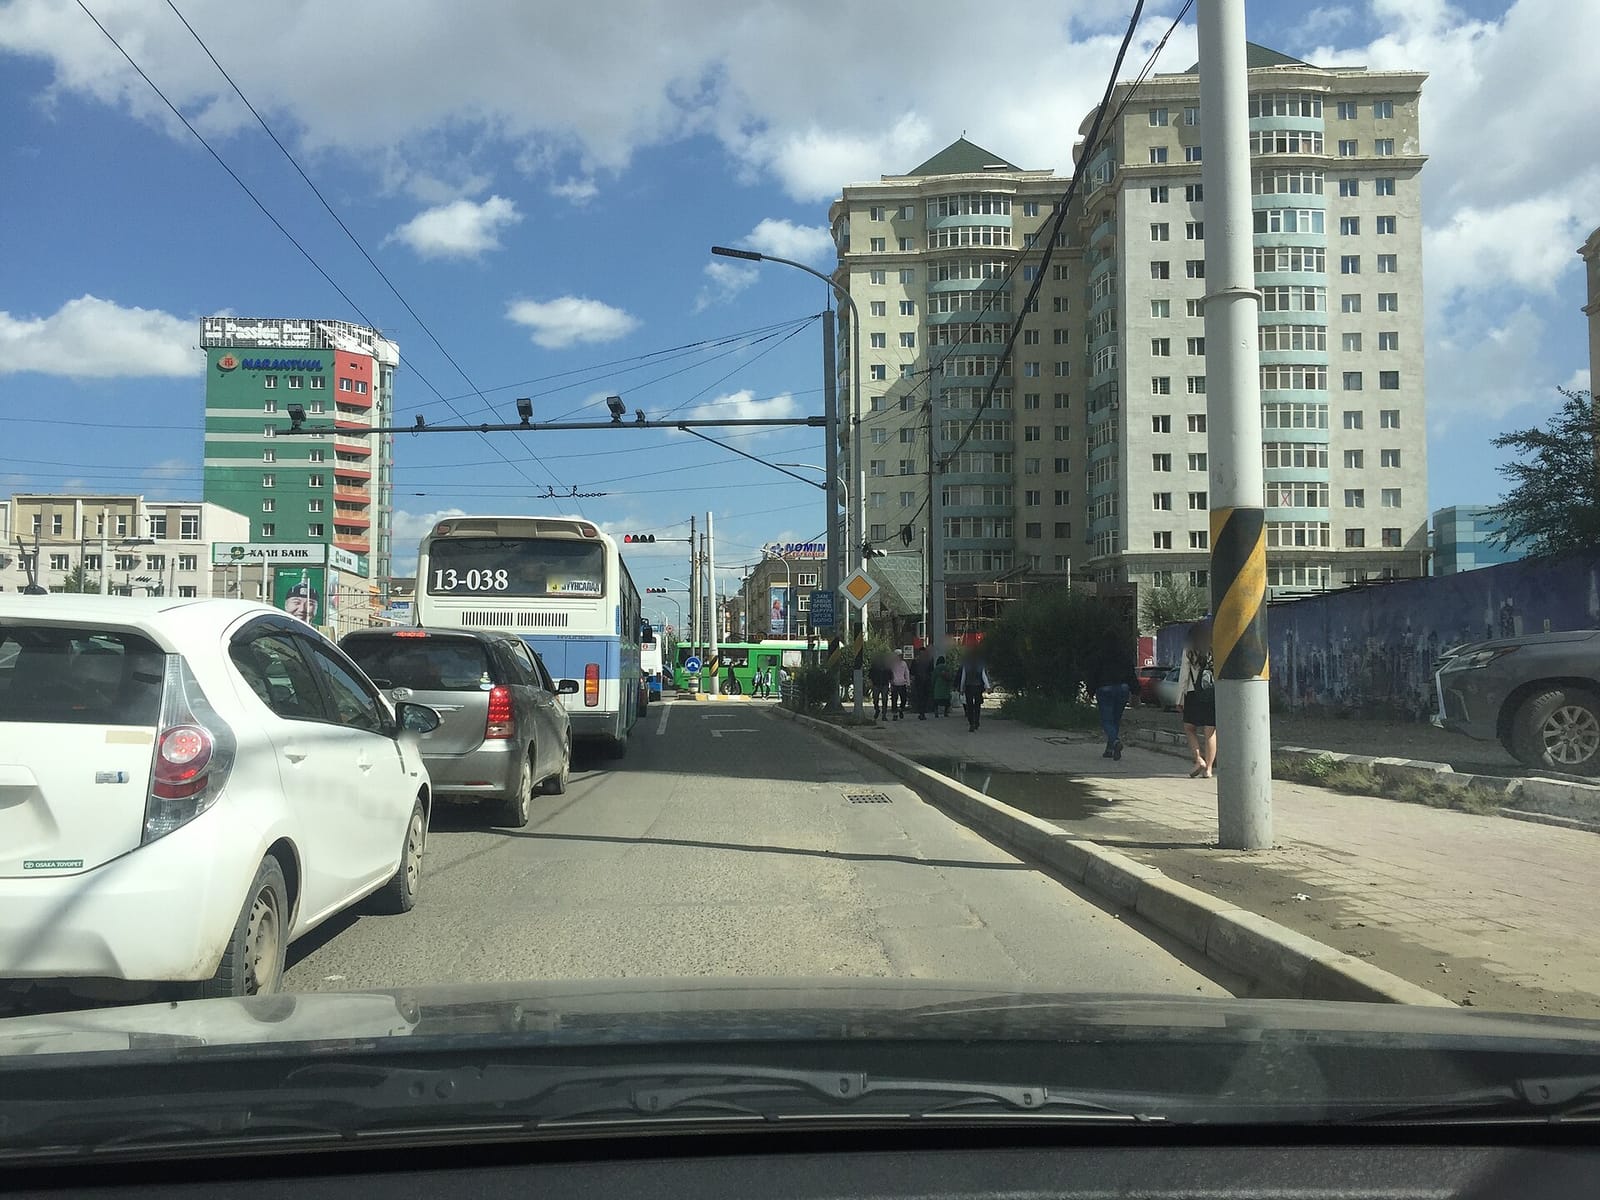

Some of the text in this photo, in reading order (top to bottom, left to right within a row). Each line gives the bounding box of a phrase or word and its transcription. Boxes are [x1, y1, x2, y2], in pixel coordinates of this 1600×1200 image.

[225, 323, 279, 339] Passion
[242, 358, 323, 371] NARANTUUL
[785, 543, 826, 552] NOMIN
[434, 569, 508, 591] 13-038
